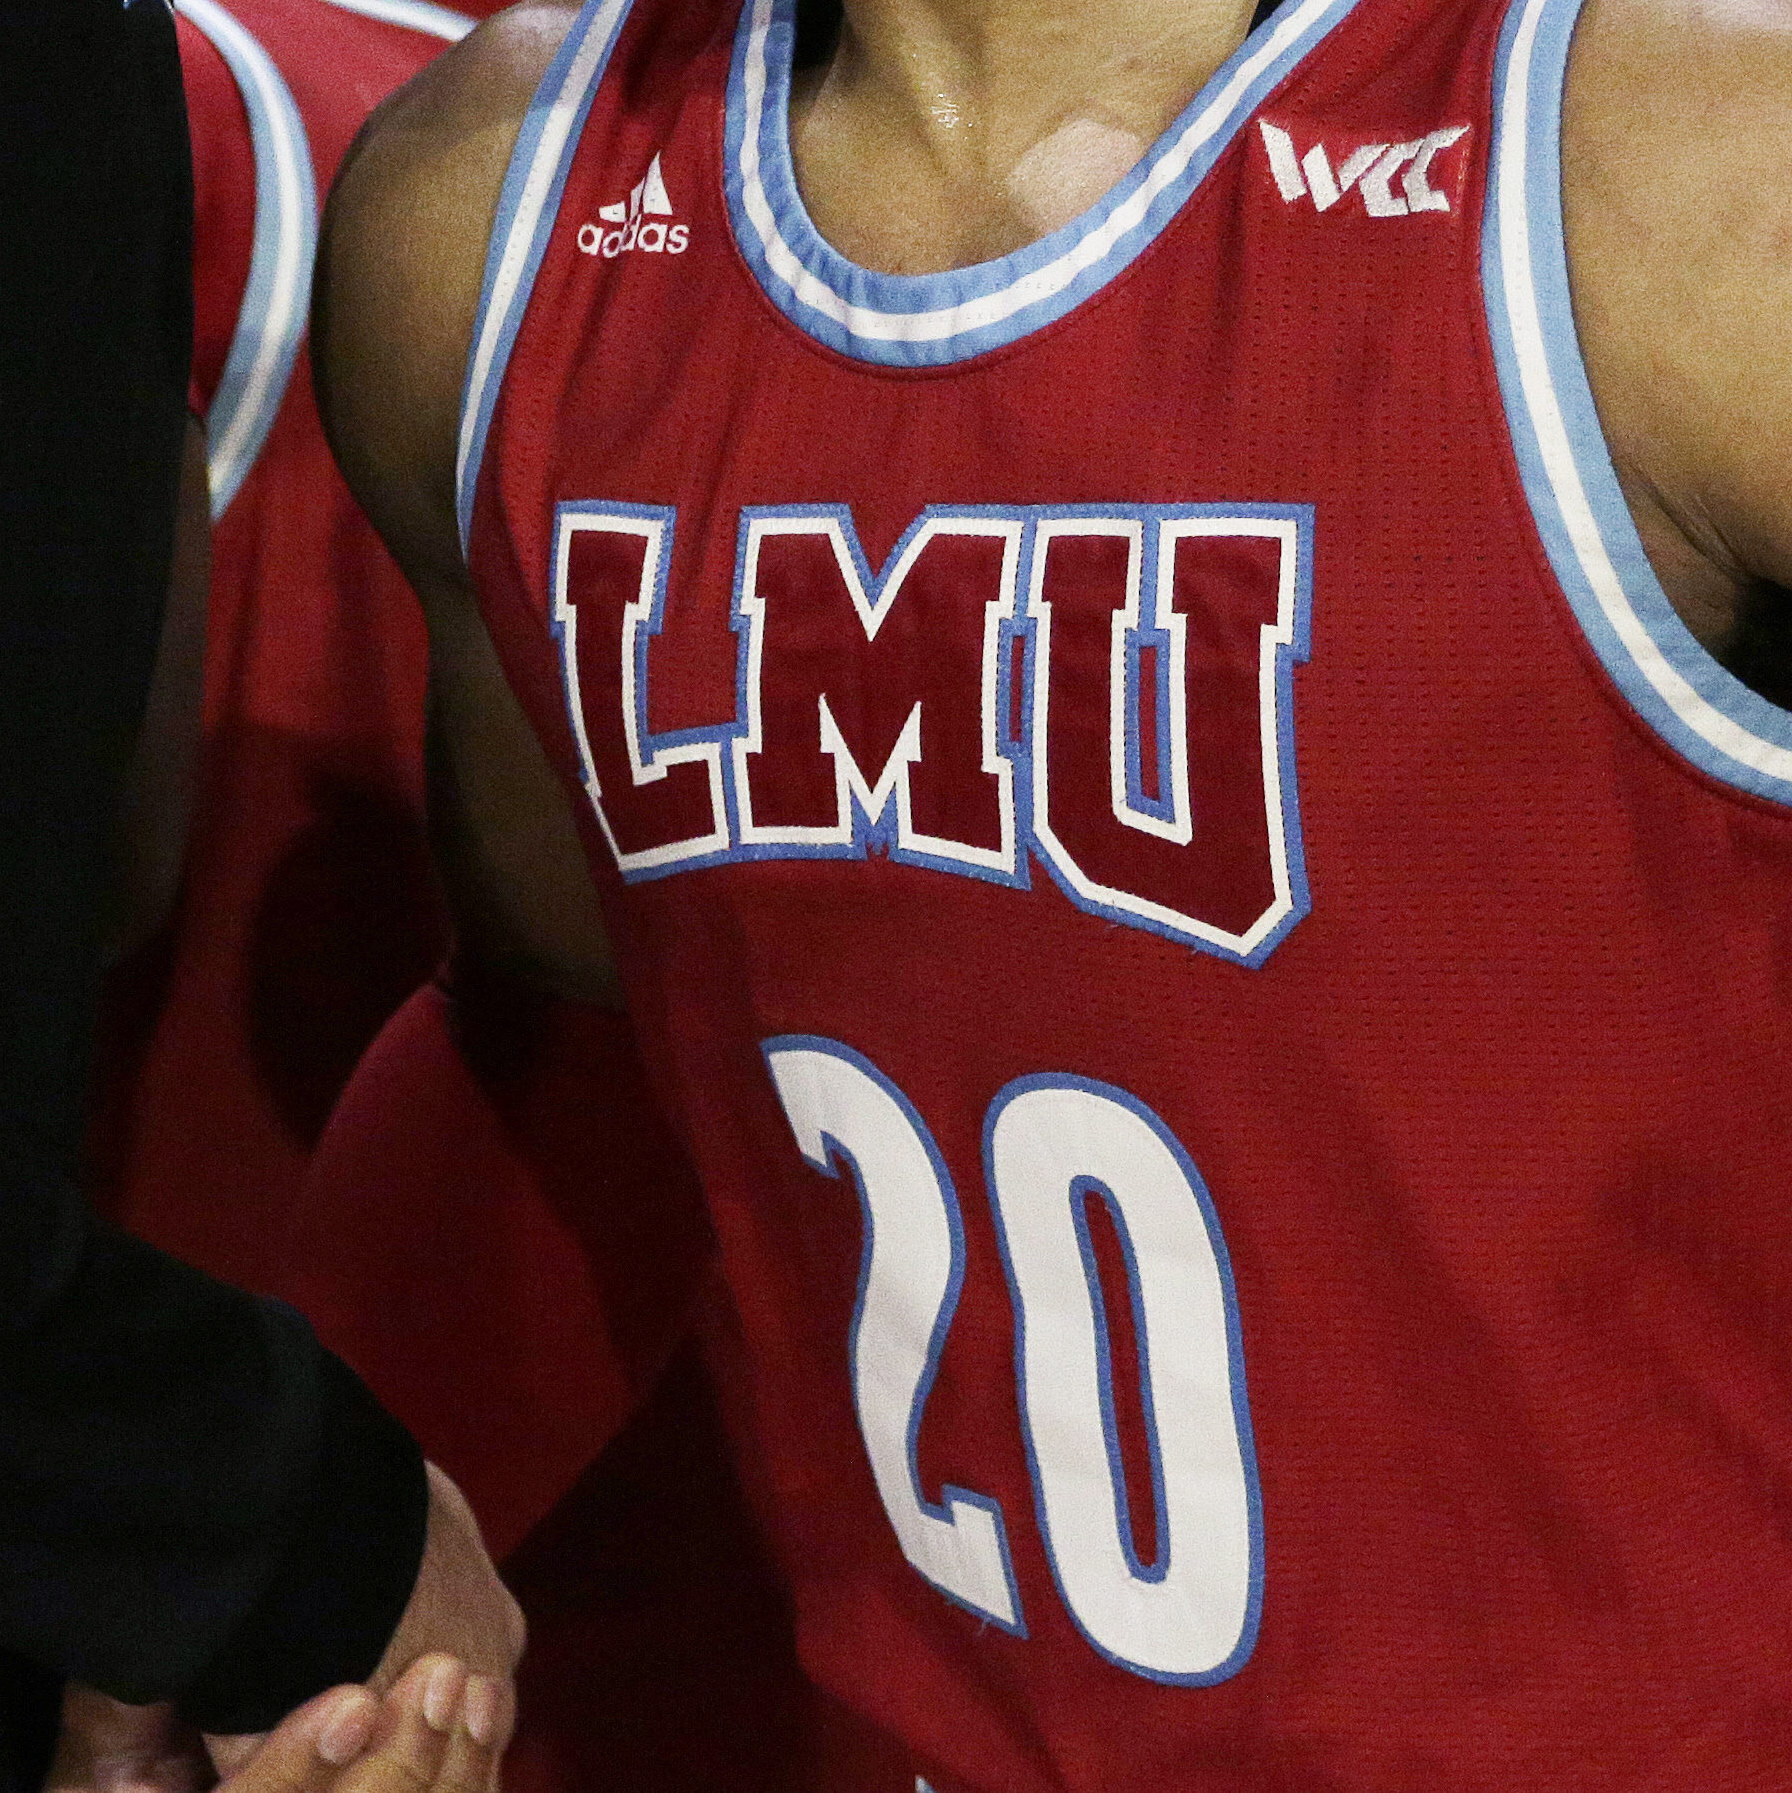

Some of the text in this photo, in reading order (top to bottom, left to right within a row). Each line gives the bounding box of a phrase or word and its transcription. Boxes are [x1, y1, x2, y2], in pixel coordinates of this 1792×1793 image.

[577, 213, 690, 258] addas
[549, 499, 1315, 970] LMU
[760, 1033, 1265, 1688] 20
